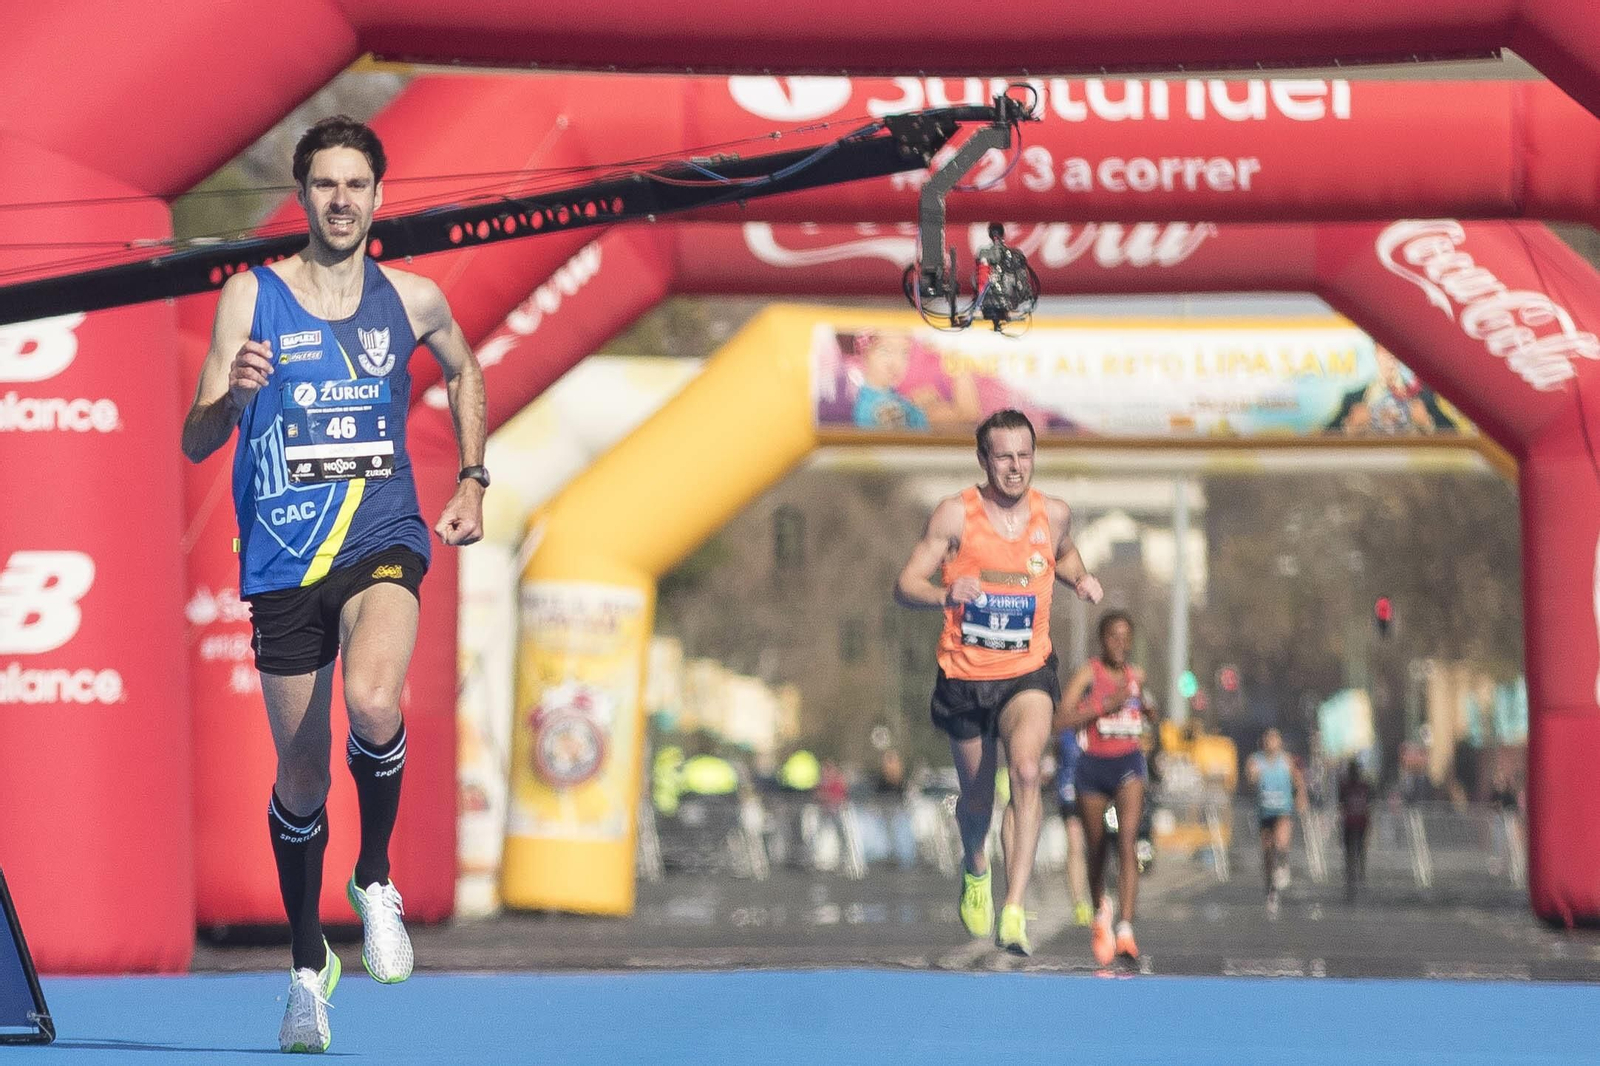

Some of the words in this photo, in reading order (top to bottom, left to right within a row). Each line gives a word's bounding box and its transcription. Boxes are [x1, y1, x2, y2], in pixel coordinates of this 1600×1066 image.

[320, 384, 379, 401] ZURICH
[0, 390, 119, 432] lance
[326, 416, 356, 438] 46
[270, 501, 317, 526] CAC
[280, 824, 321, 843] SPORTLAST
